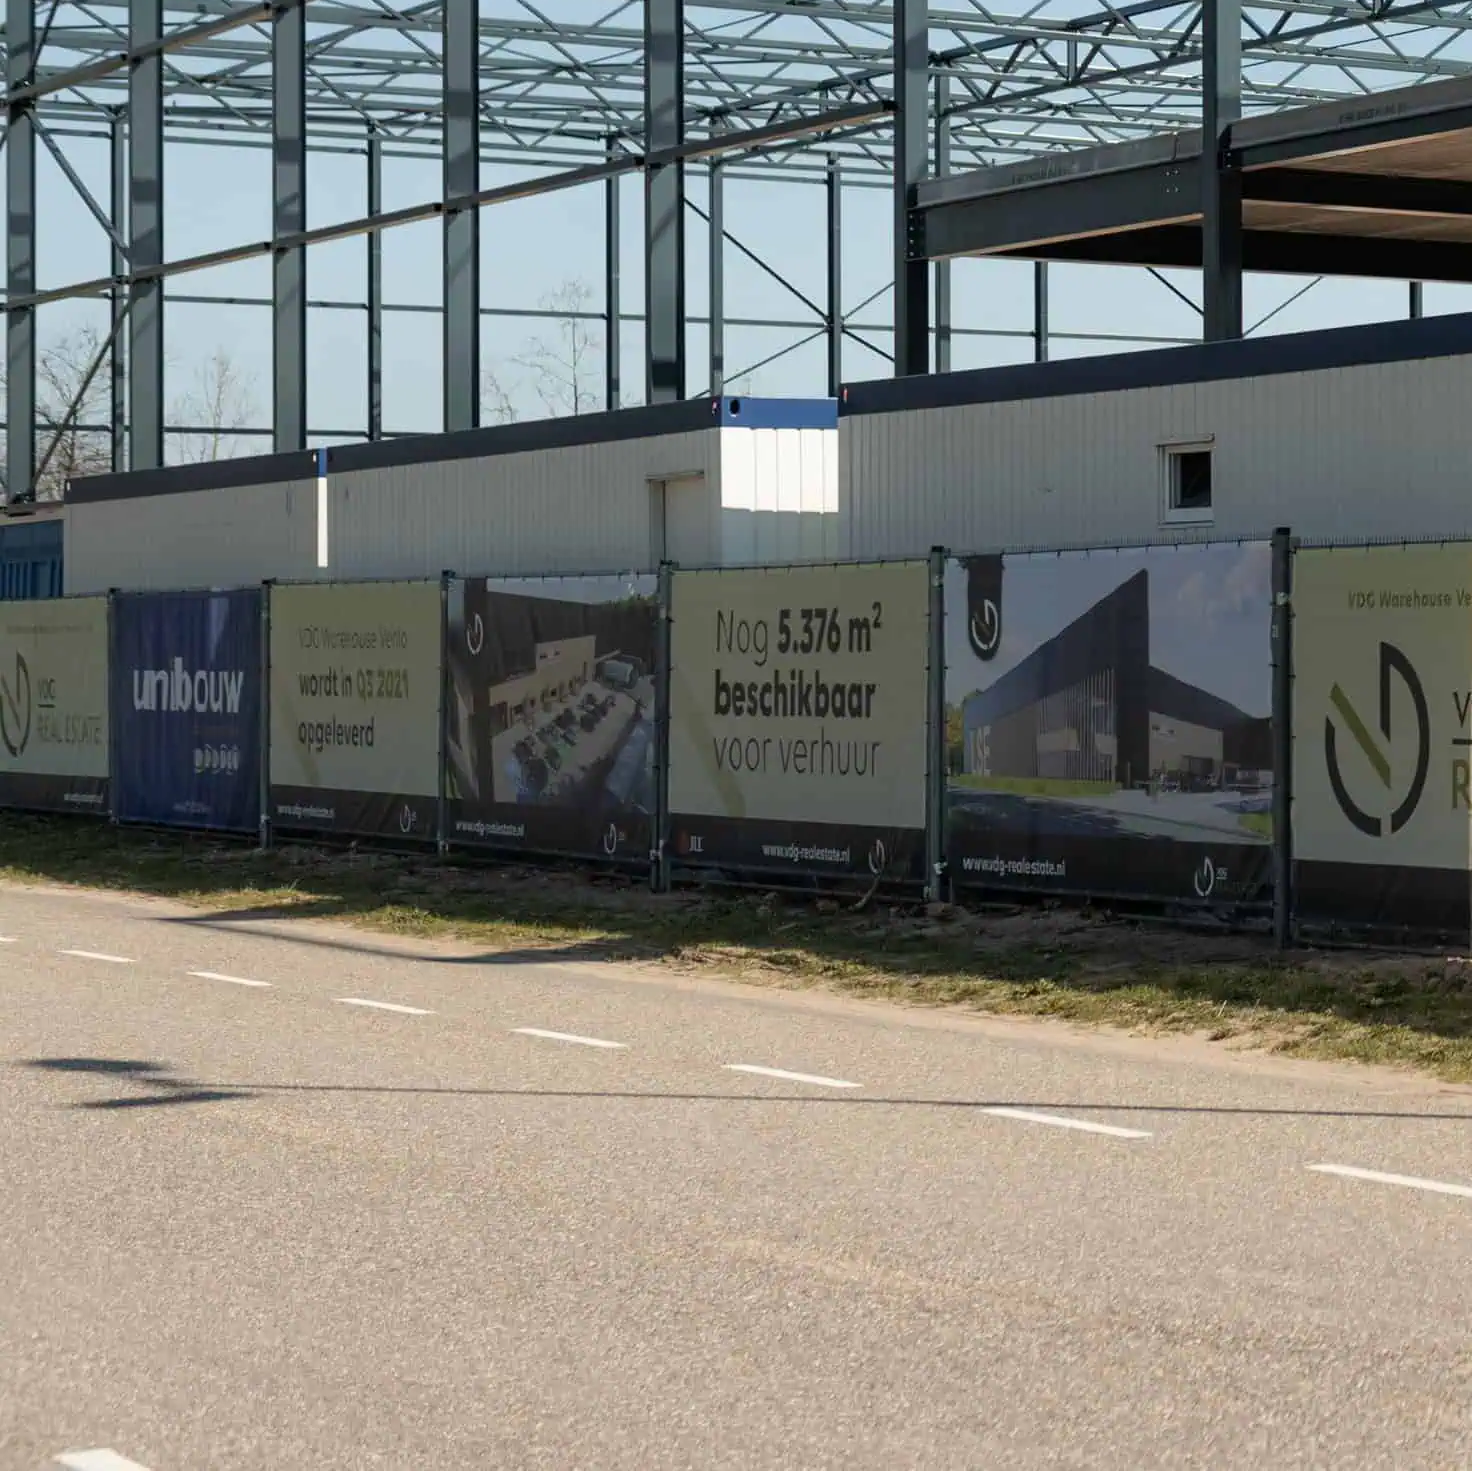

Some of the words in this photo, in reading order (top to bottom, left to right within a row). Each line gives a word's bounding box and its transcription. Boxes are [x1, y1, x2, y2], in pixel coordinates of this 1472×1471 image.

[1348, 590, 1376, 609] VDG
[1379, 589, 1451, 608] Warehouse
[715, 609, 769, 667] Nog
[777, 606, 842, 654] 5.376
[133, 656, 244, 714] unibouw
[298, 666, 340, 697] wordt
[340, 666, 353, 698] in
[356, 669, 375, 703] Q3
[376, 668, 410, 701] 2021
[713, 668, 877, 719] beschikbaar
[298, 715, 375, 753] opgeleverd
[713, 736, 772, 773] voor
[779, 726, 882, 777] verhuur
